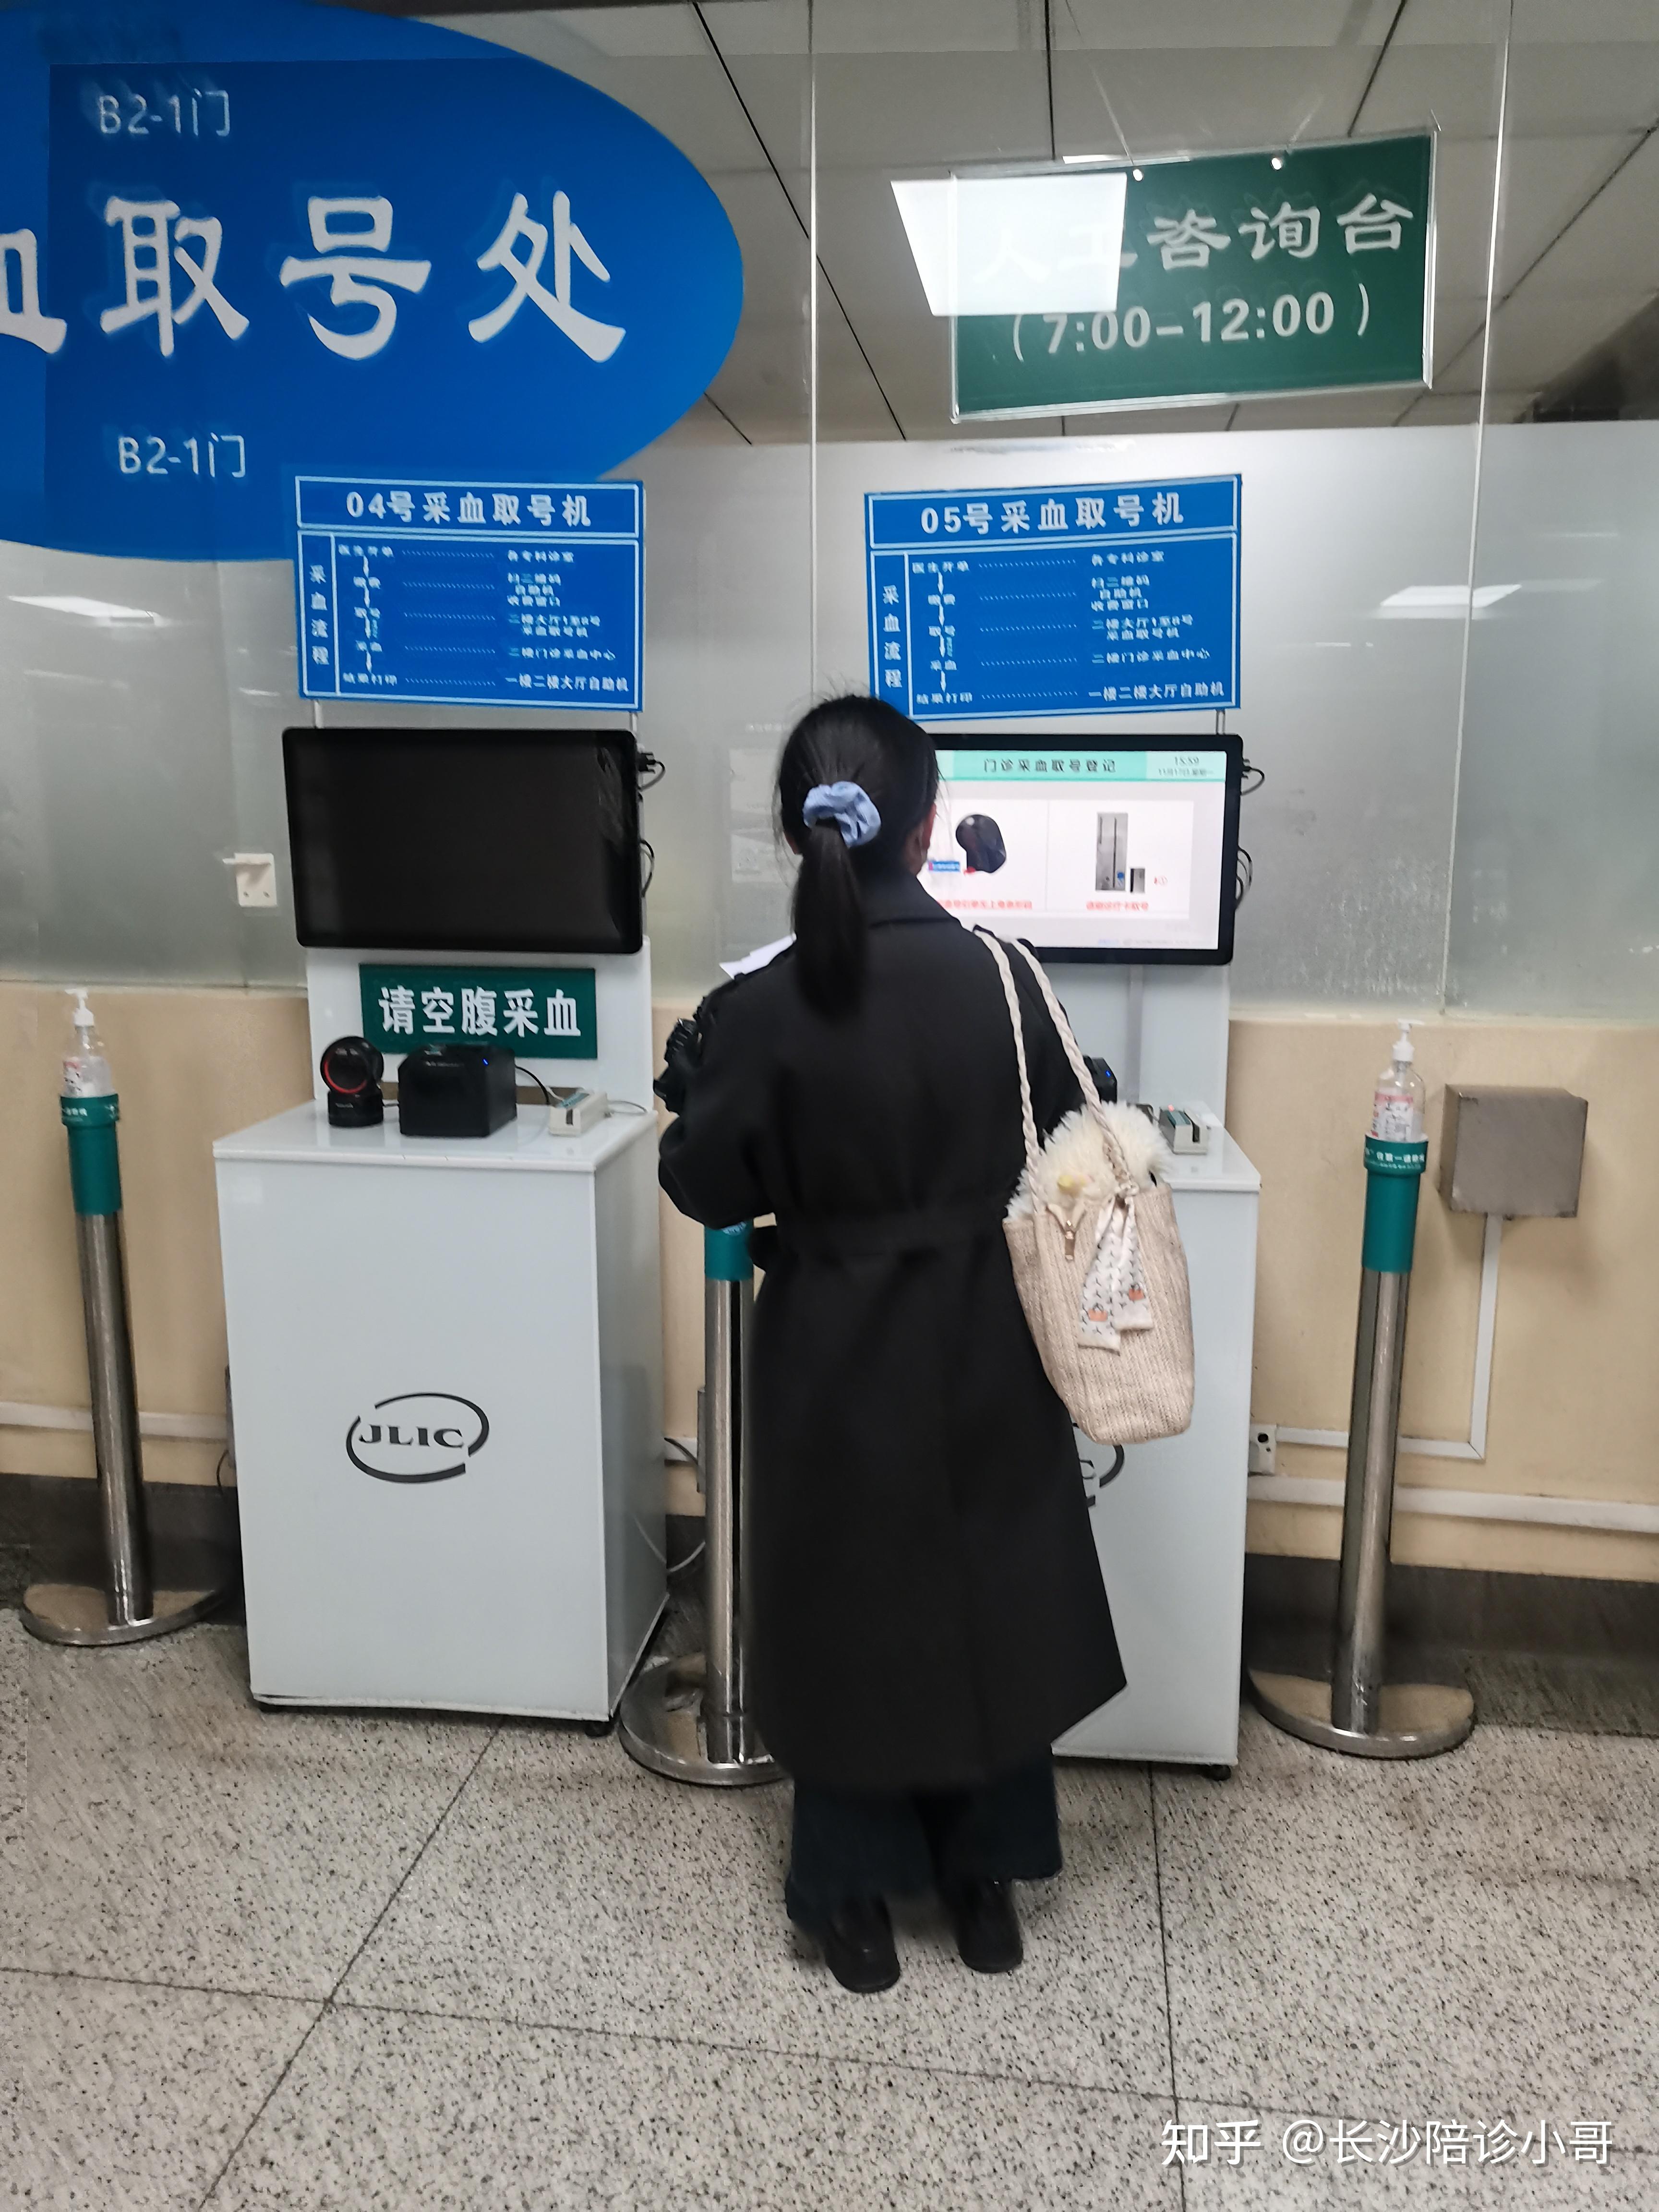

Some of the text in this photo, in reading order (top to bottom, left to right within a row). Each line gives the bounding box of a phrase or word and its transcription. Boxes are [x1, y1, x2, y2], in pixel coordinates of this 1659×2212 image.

[99, 89, 230, 137] B2-1门
[119, 433, 245, 478] B2-1门
[347, 491, 591, 527] 04号采血取号机
[921, 493, 1184, 534] 05号采血取号机
[882, 585, 902, 689] 采血流程
[1088, 681, 1225, 702] 一楼二楼大厅自助机
[984, 758, 1116, 772] 门诊采血取号登记
[378, 986, 581, 1037] 请空腹采血
[359, 1424, 465, 1448] JLIC
